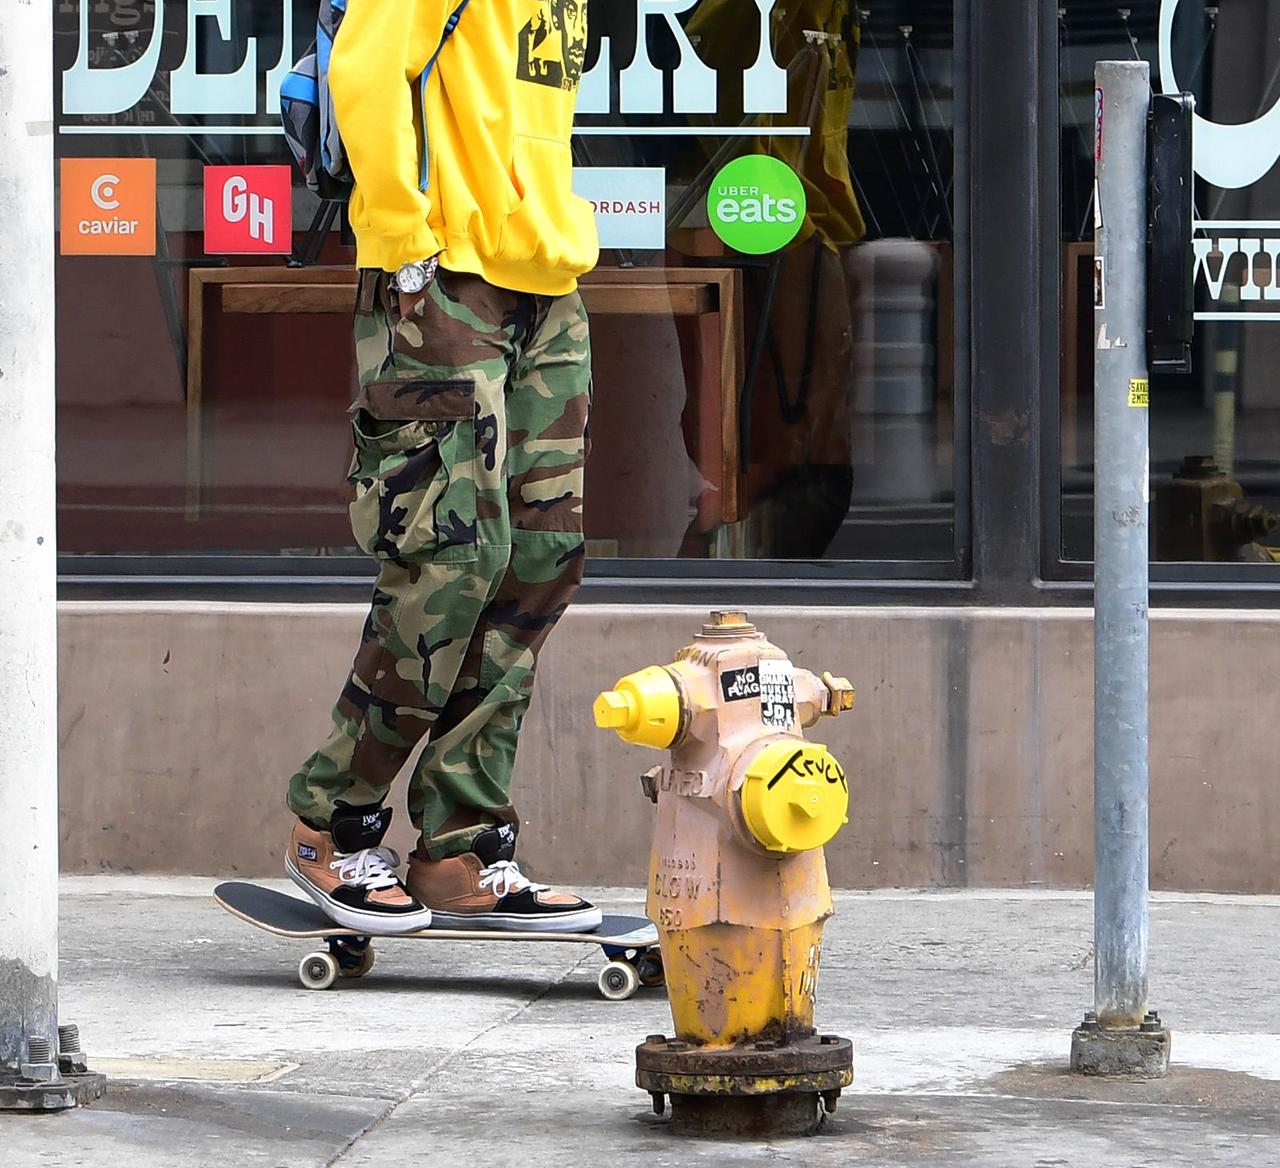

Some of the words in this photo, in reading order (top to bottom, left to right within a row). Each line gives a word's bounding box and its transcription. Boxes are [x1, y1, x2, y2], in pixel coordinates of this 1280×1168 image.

[717, 186, 759, 196] UBER
[716, 193, 797, 223] eats
[78, 216, 139, 234] caviar
